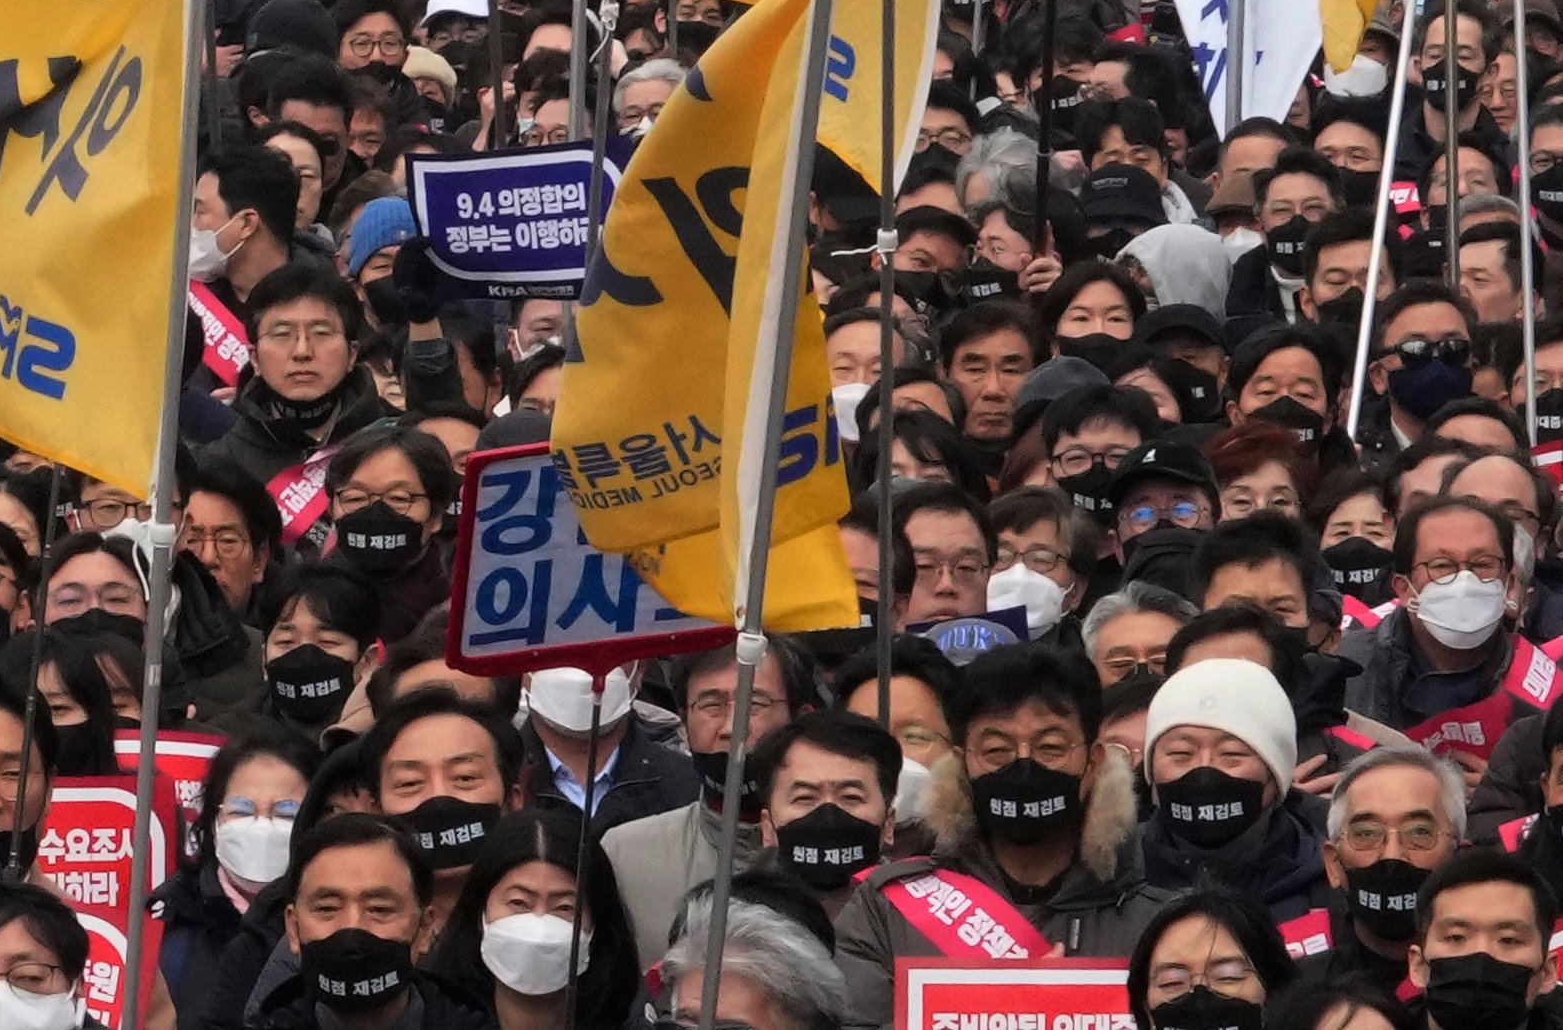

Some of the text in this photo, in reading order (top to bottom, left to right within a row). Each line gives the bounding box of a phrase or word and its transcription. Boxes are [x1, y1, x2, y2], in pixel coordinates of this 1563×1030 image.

[457, 181, 586, 220] 9.4 의정합의
[444, 225, 513, 254] 정부는
[468, 549, 702, 648] 의사
[300, 677, 342, 699] 재검토
[989, 795, 1067, 819] 원점 재검토
[1170, 801, 1245, 822] 원점 재검토
[438, 821, 486, 847] 재검토
[792, 845, 865, 865] 원점 재검토
[1357, 888, 1382, 911] 원점
[317, 970, 399, 997] 원점 재검토
